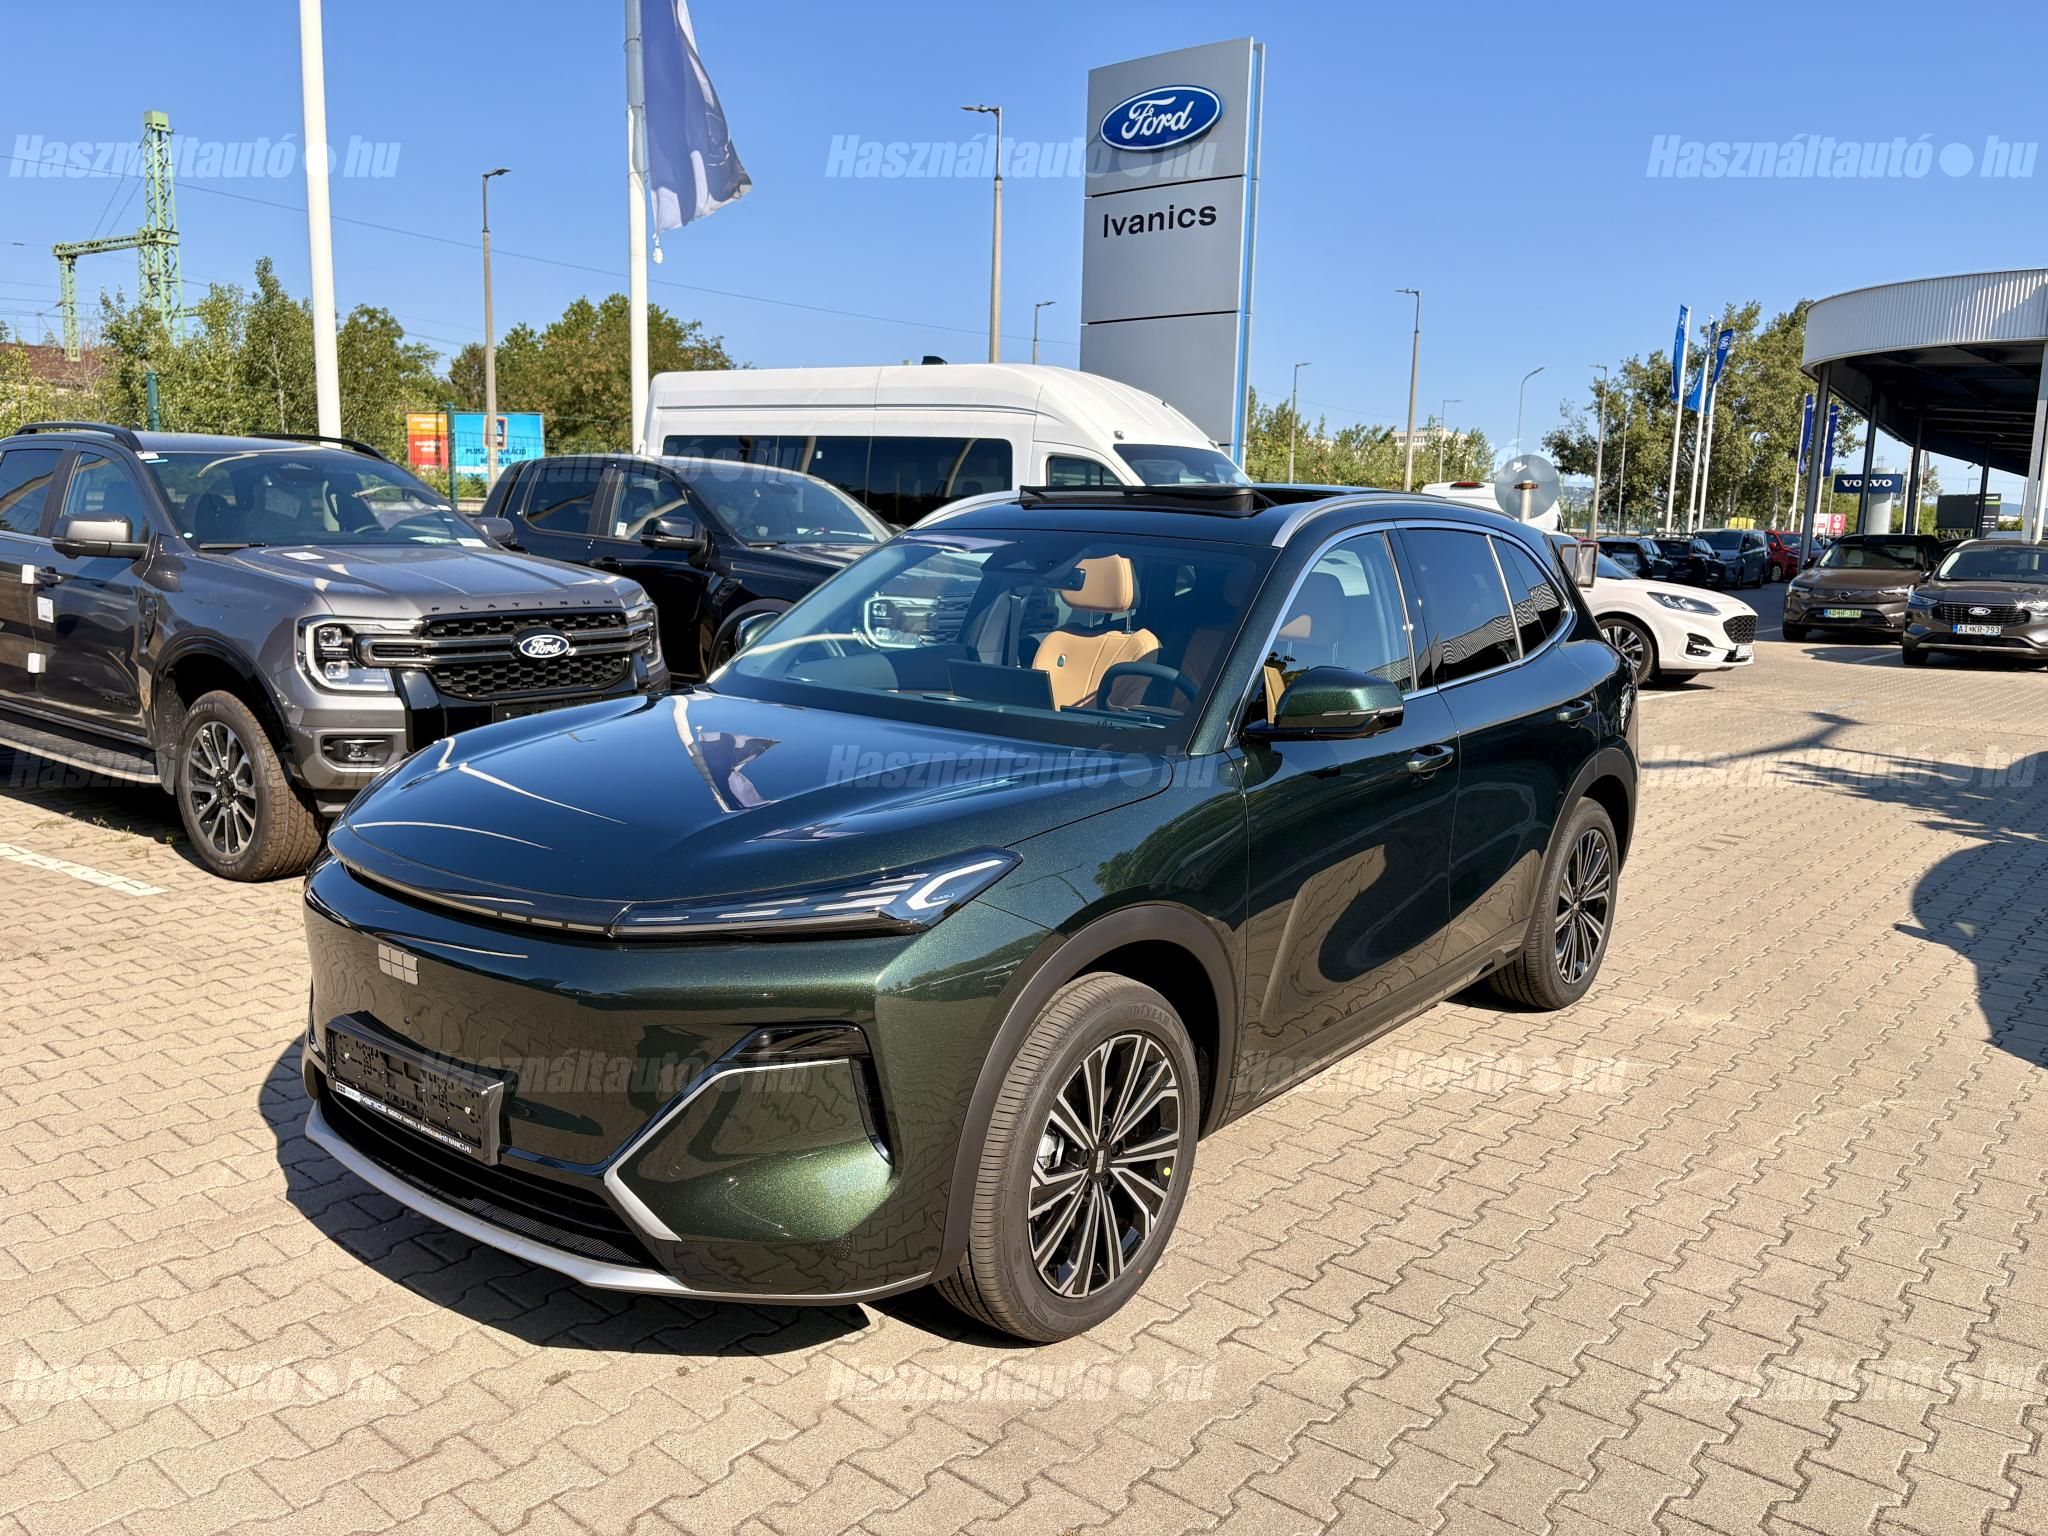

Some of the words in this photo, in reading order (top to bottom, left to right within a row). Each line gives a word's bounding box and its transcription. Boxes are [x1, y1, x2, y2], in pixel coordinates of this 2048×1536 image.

[1121, 96, 1195, 140] Ford
[1103, 204, 1217, 238] Ivanics
[431, 599, 614, 612] PLATINUM
[528, 637, 561, 656] Ford
